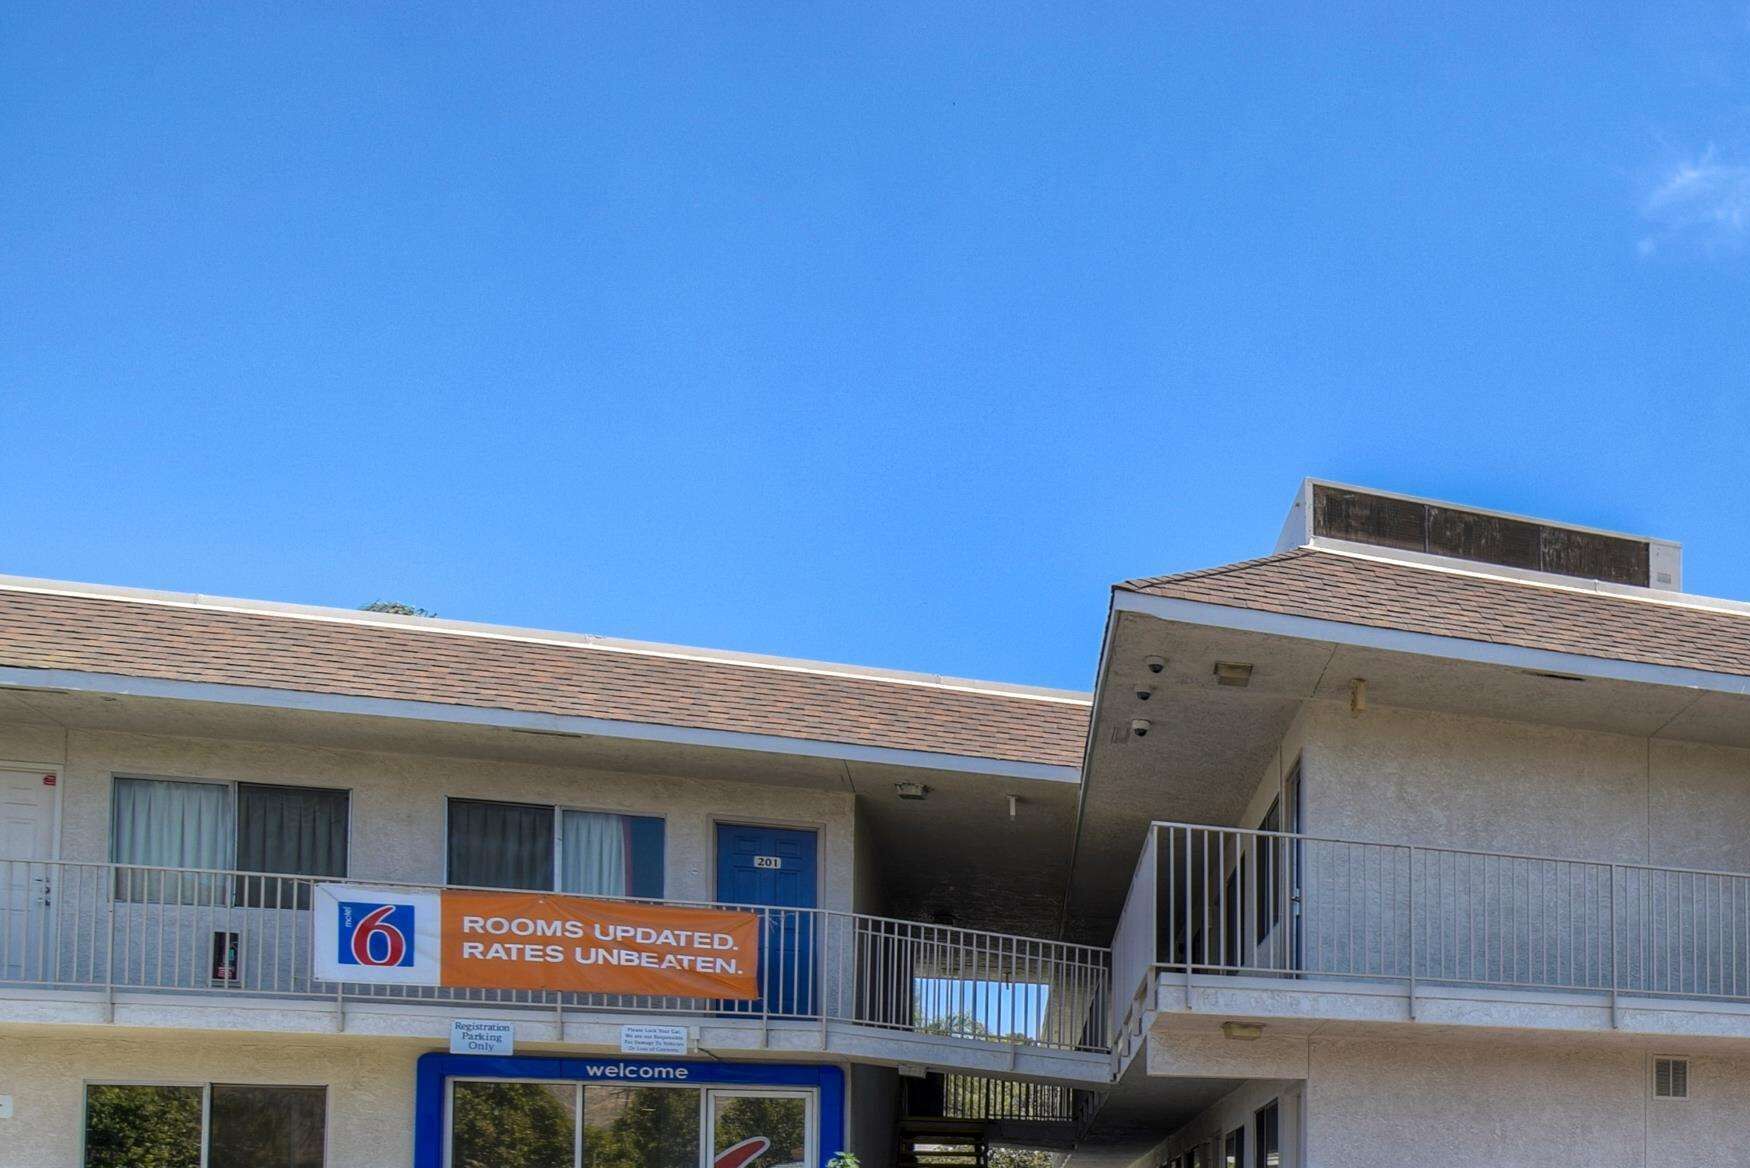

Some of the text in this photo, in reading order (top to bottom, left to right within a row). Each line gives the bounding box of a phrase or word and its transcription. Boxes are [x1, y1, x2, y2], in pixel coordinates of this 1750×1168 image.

[757, 857, 779, 868] 201
[351, 904, 407, 968] 6
[462, 915, 740, 951] ROOMS UPDATED.
[462, 941, 744, 975] RATES UNBEATEN.
[455, 1021, 510, 1032] Registration
[463, 1031, 502, 1044] Parking
[468, 1041, 496, 1052] Only
[586, 1063, 689, 1079] welcome
